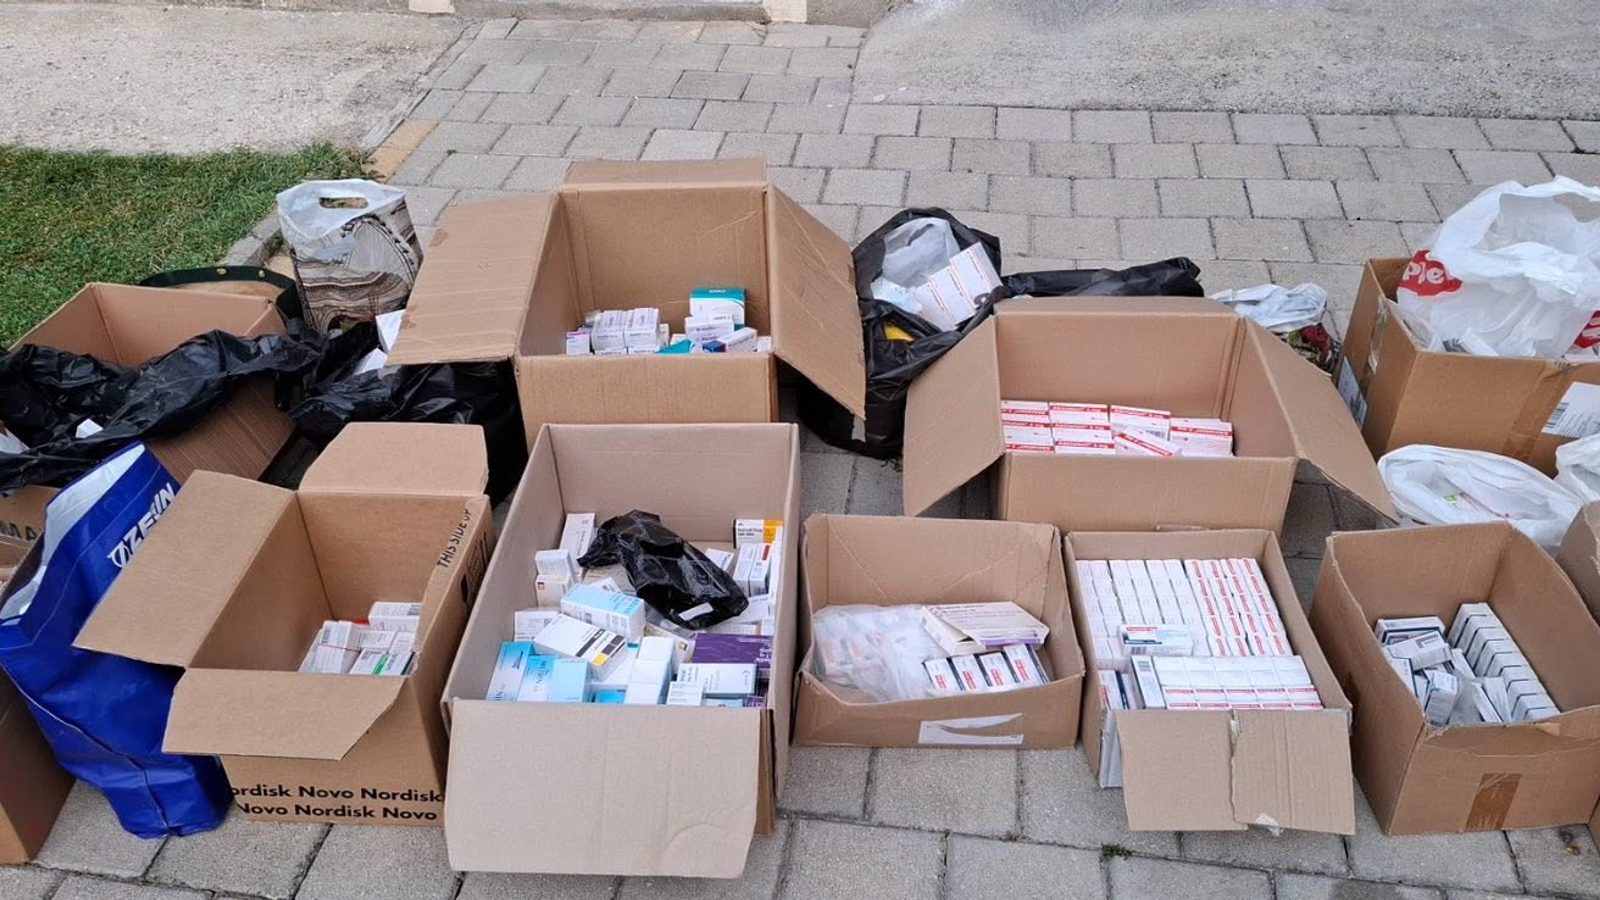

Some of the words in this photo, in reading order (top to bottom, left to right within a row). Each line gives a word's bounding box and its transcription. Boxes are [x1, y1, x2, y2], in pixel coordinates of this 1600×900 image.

[437, 545, 457, 568] THIS
[449, 522, 468, 546] SIDE
[231, 784, 292, 797] ordisk
[298, 785, 354, 799] Novo
[361, 787, 444, 803] Nordisk
[237, 803, 288, 815] Novo
[294, 804, 375, 818] Nordisk
[383, 807, 437, 820] Novo
